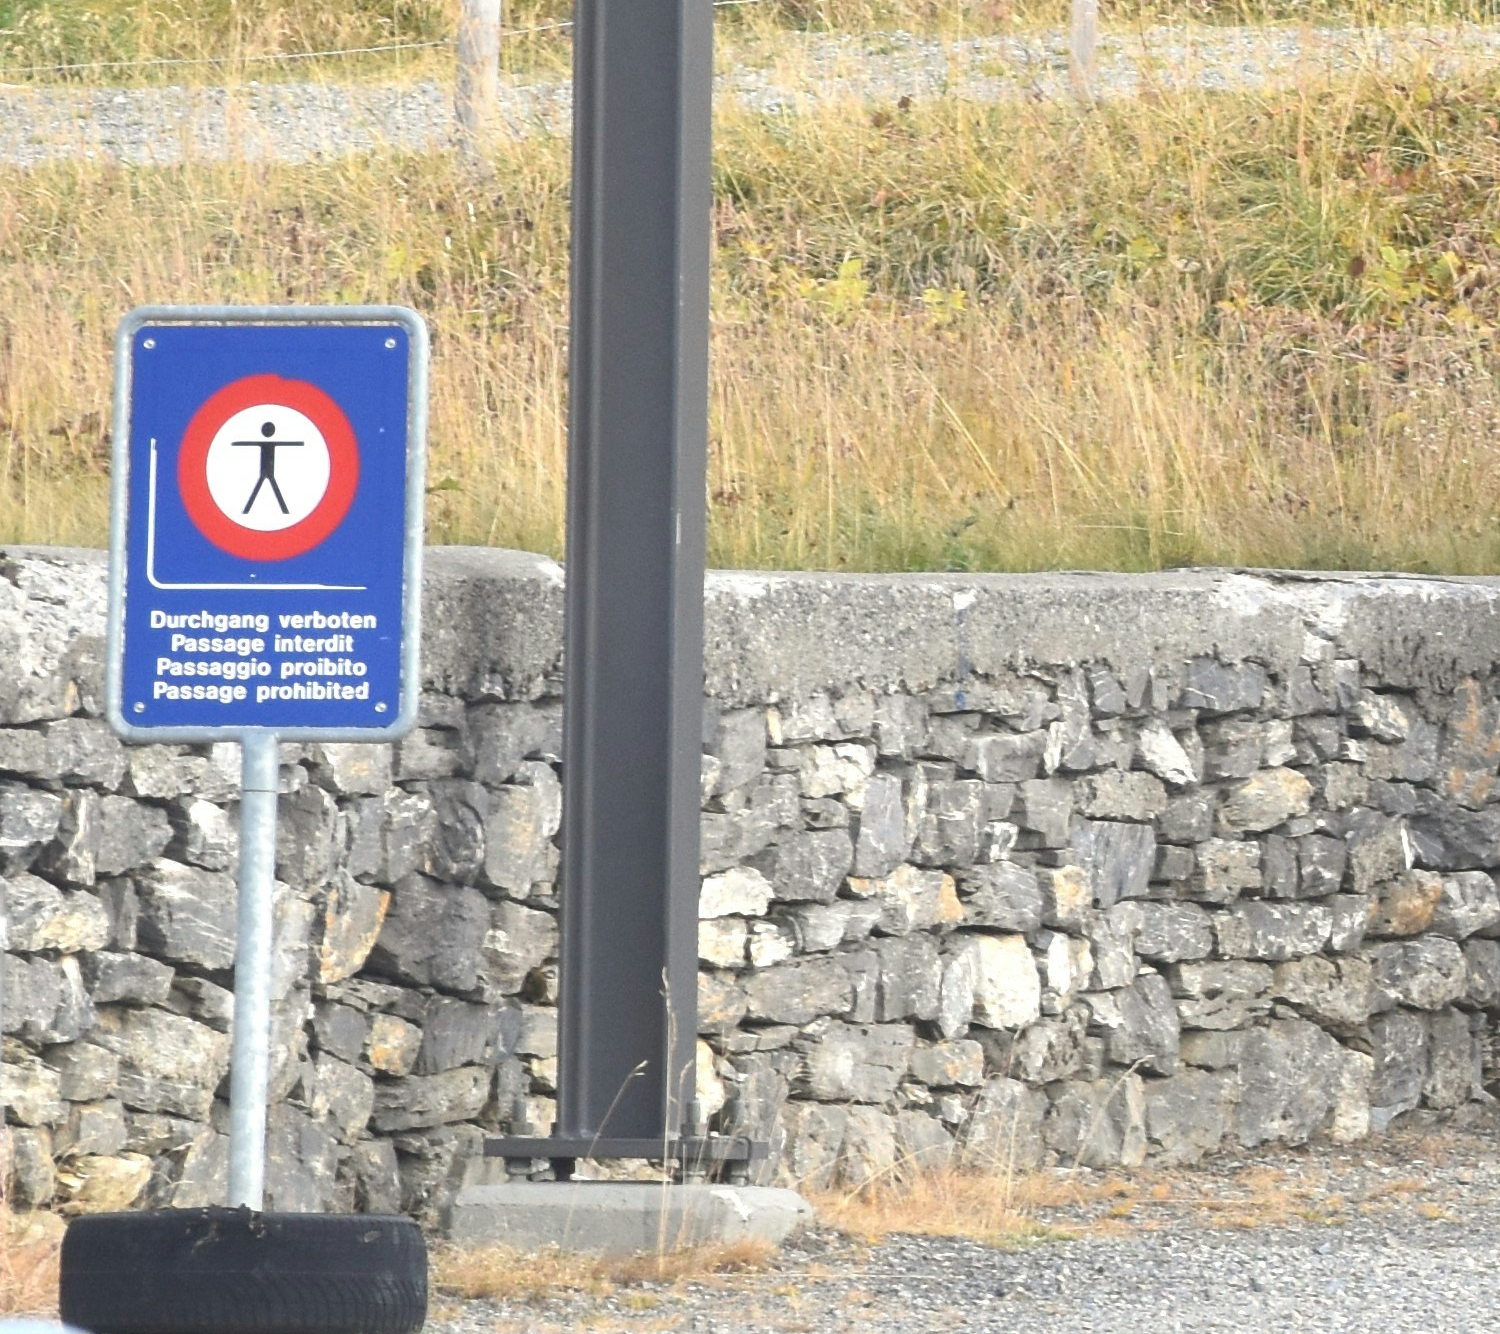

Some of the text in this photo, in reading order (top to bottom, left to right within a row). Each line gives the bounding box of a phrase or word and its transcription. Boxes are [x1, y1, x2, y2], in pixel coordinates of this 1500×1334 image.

[150, 610, 377, 633] Durchgang verboten
[171, 633, 354, 656] Passage interdit
[156, 657, 368, 680] Passaggio proibito
[153, 681, 370, 704] Passage prohibited
